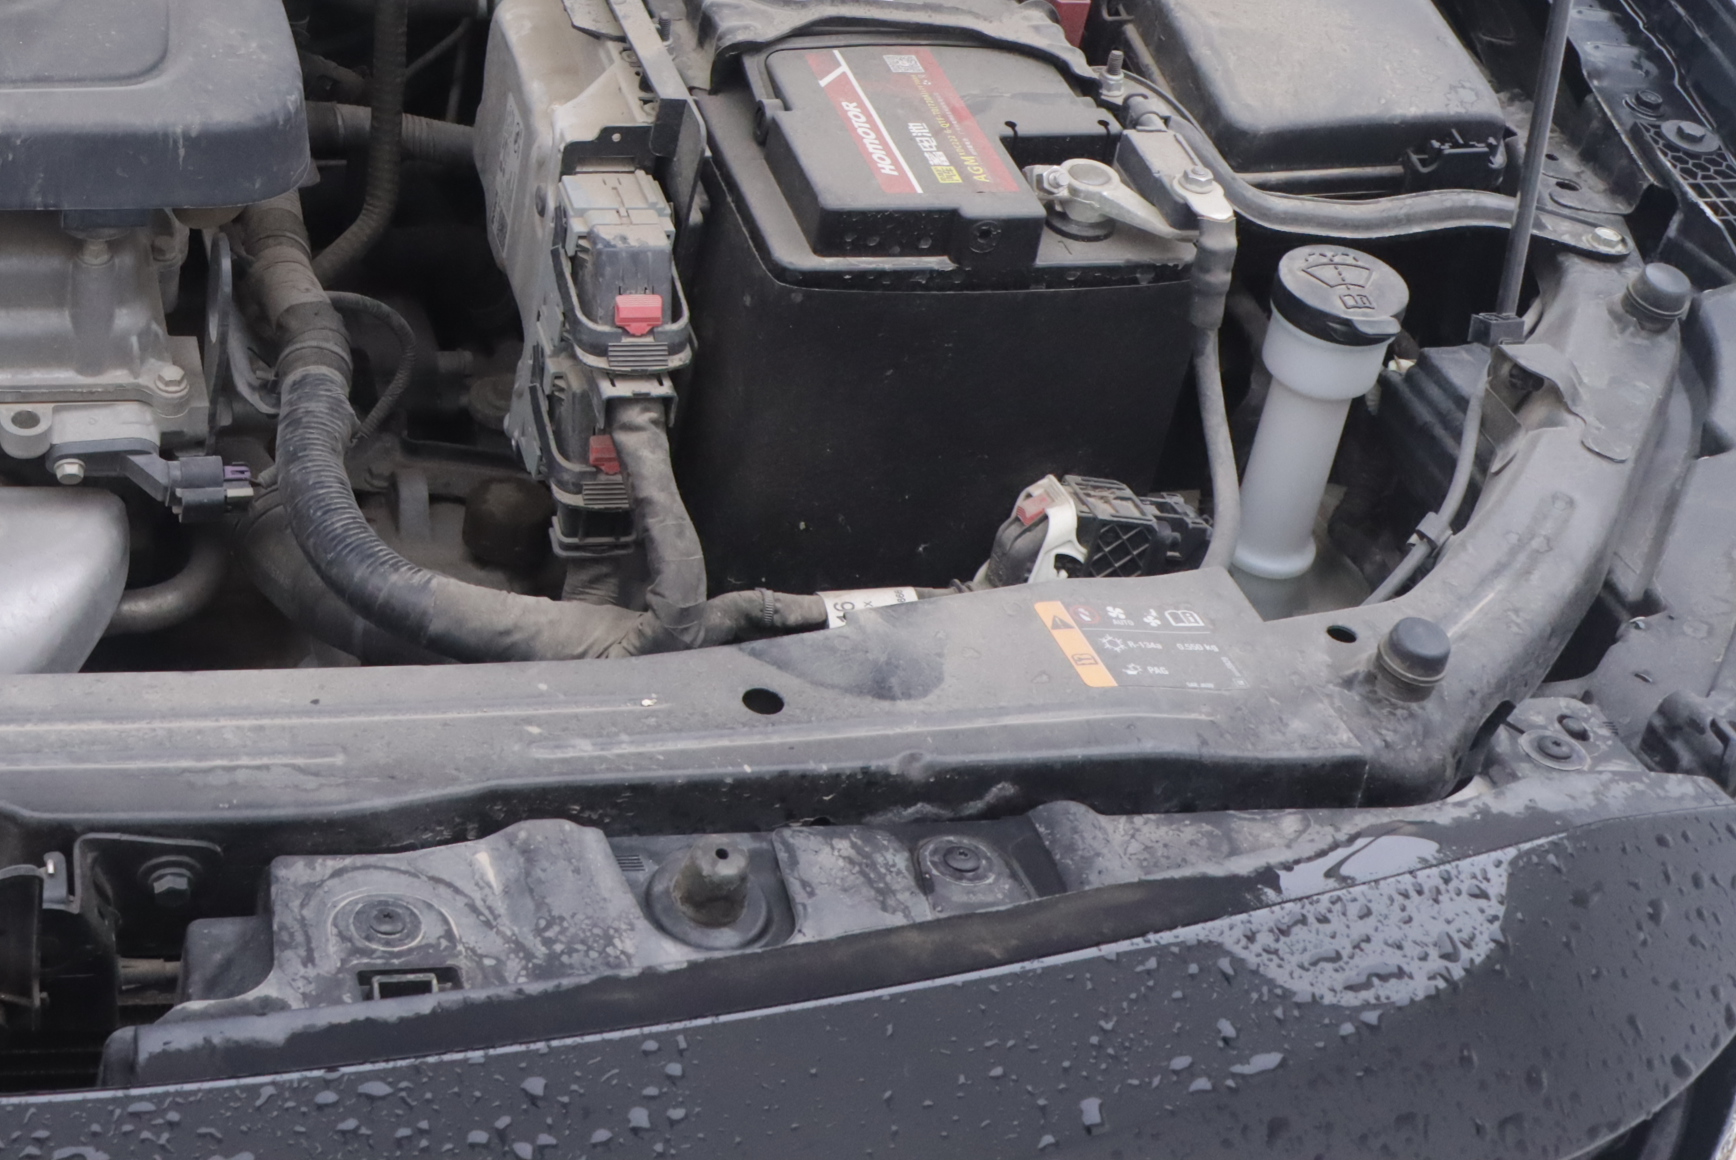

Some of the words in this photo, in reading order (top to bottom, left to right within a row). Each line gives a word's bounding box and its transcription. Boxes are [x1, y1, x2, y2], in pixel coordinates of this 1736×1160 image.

[960, 156, 990, 182] AGM
[1113, 619, 1134, 627] AUTO
[1127, 640, 1163, 650] R-134a
[1204, 643, 1220, 653] kg
[1146, 666, 1170, 676] PAG
